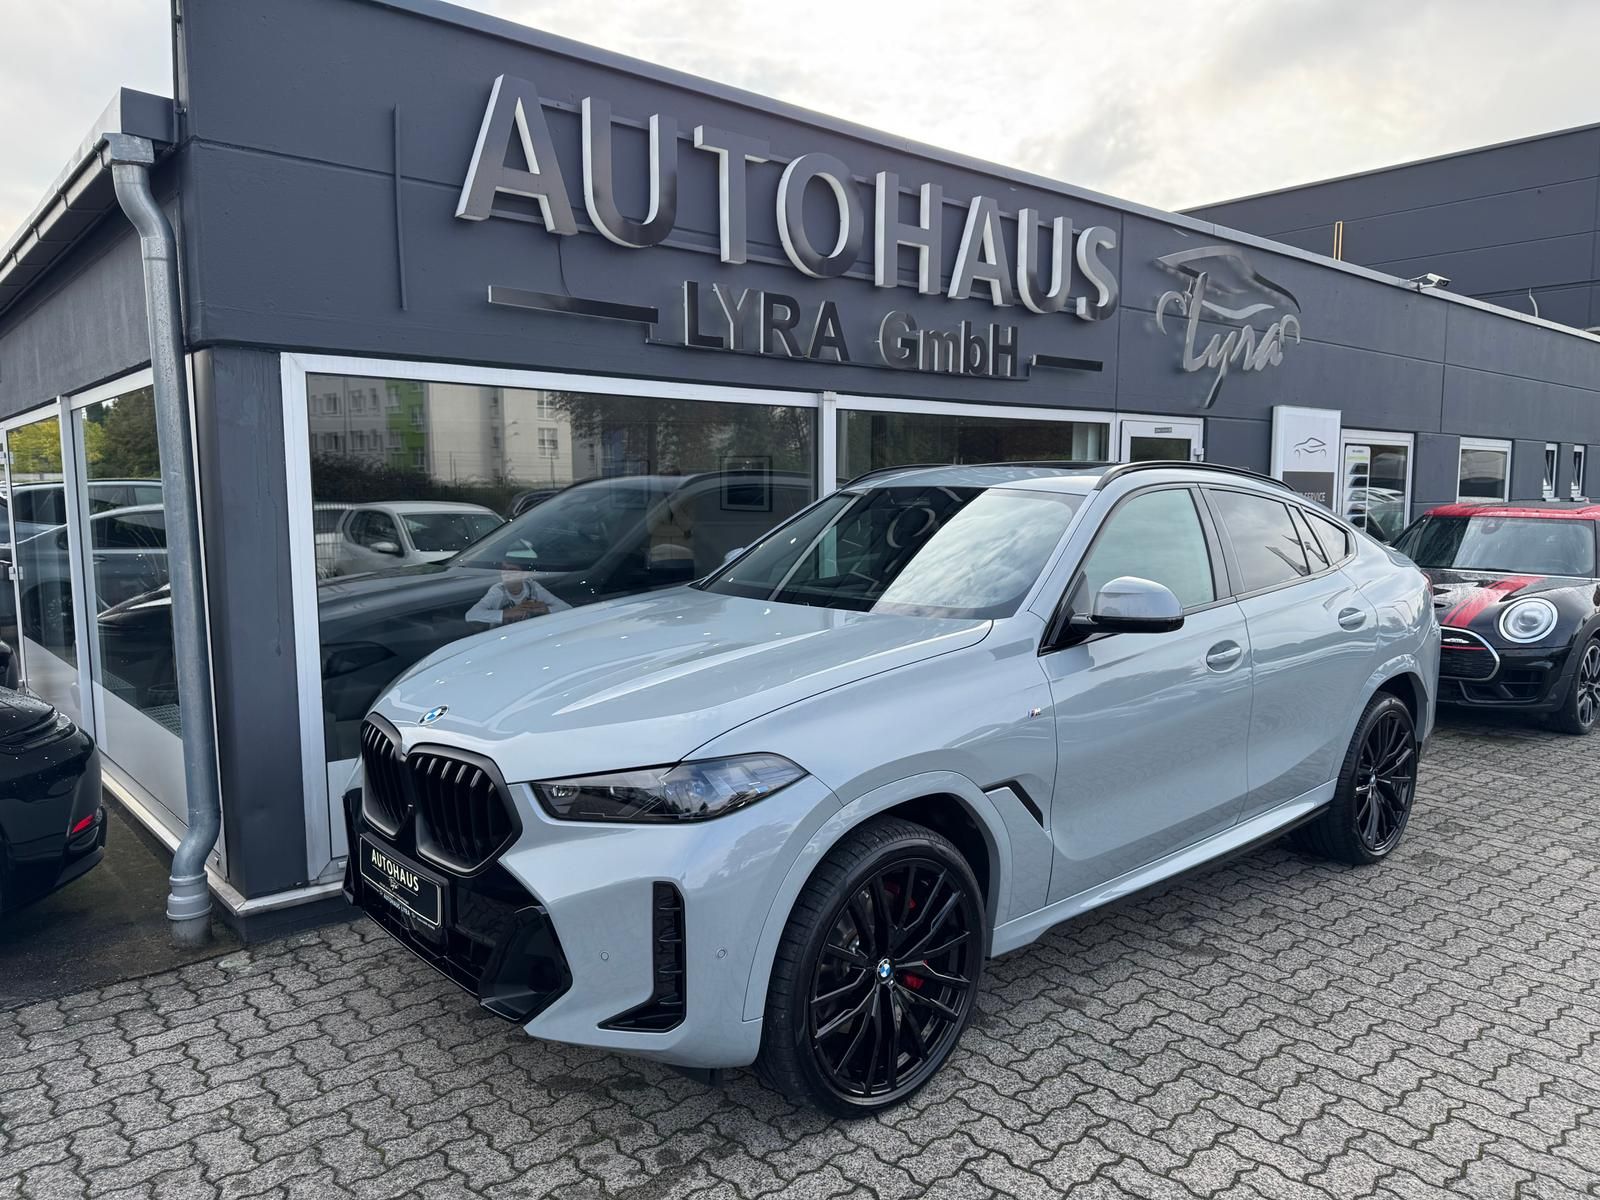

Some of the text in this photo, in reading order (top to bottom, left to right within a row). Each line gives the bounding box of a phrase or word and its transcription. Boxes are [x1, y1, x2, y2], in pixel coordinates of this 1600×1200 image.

[455, 74, 1119, 321] AUTOHAUS
[684, 280, 1018, 377] LYRA GmbH
[371, 849, 419, 892] AUTOHAUS
